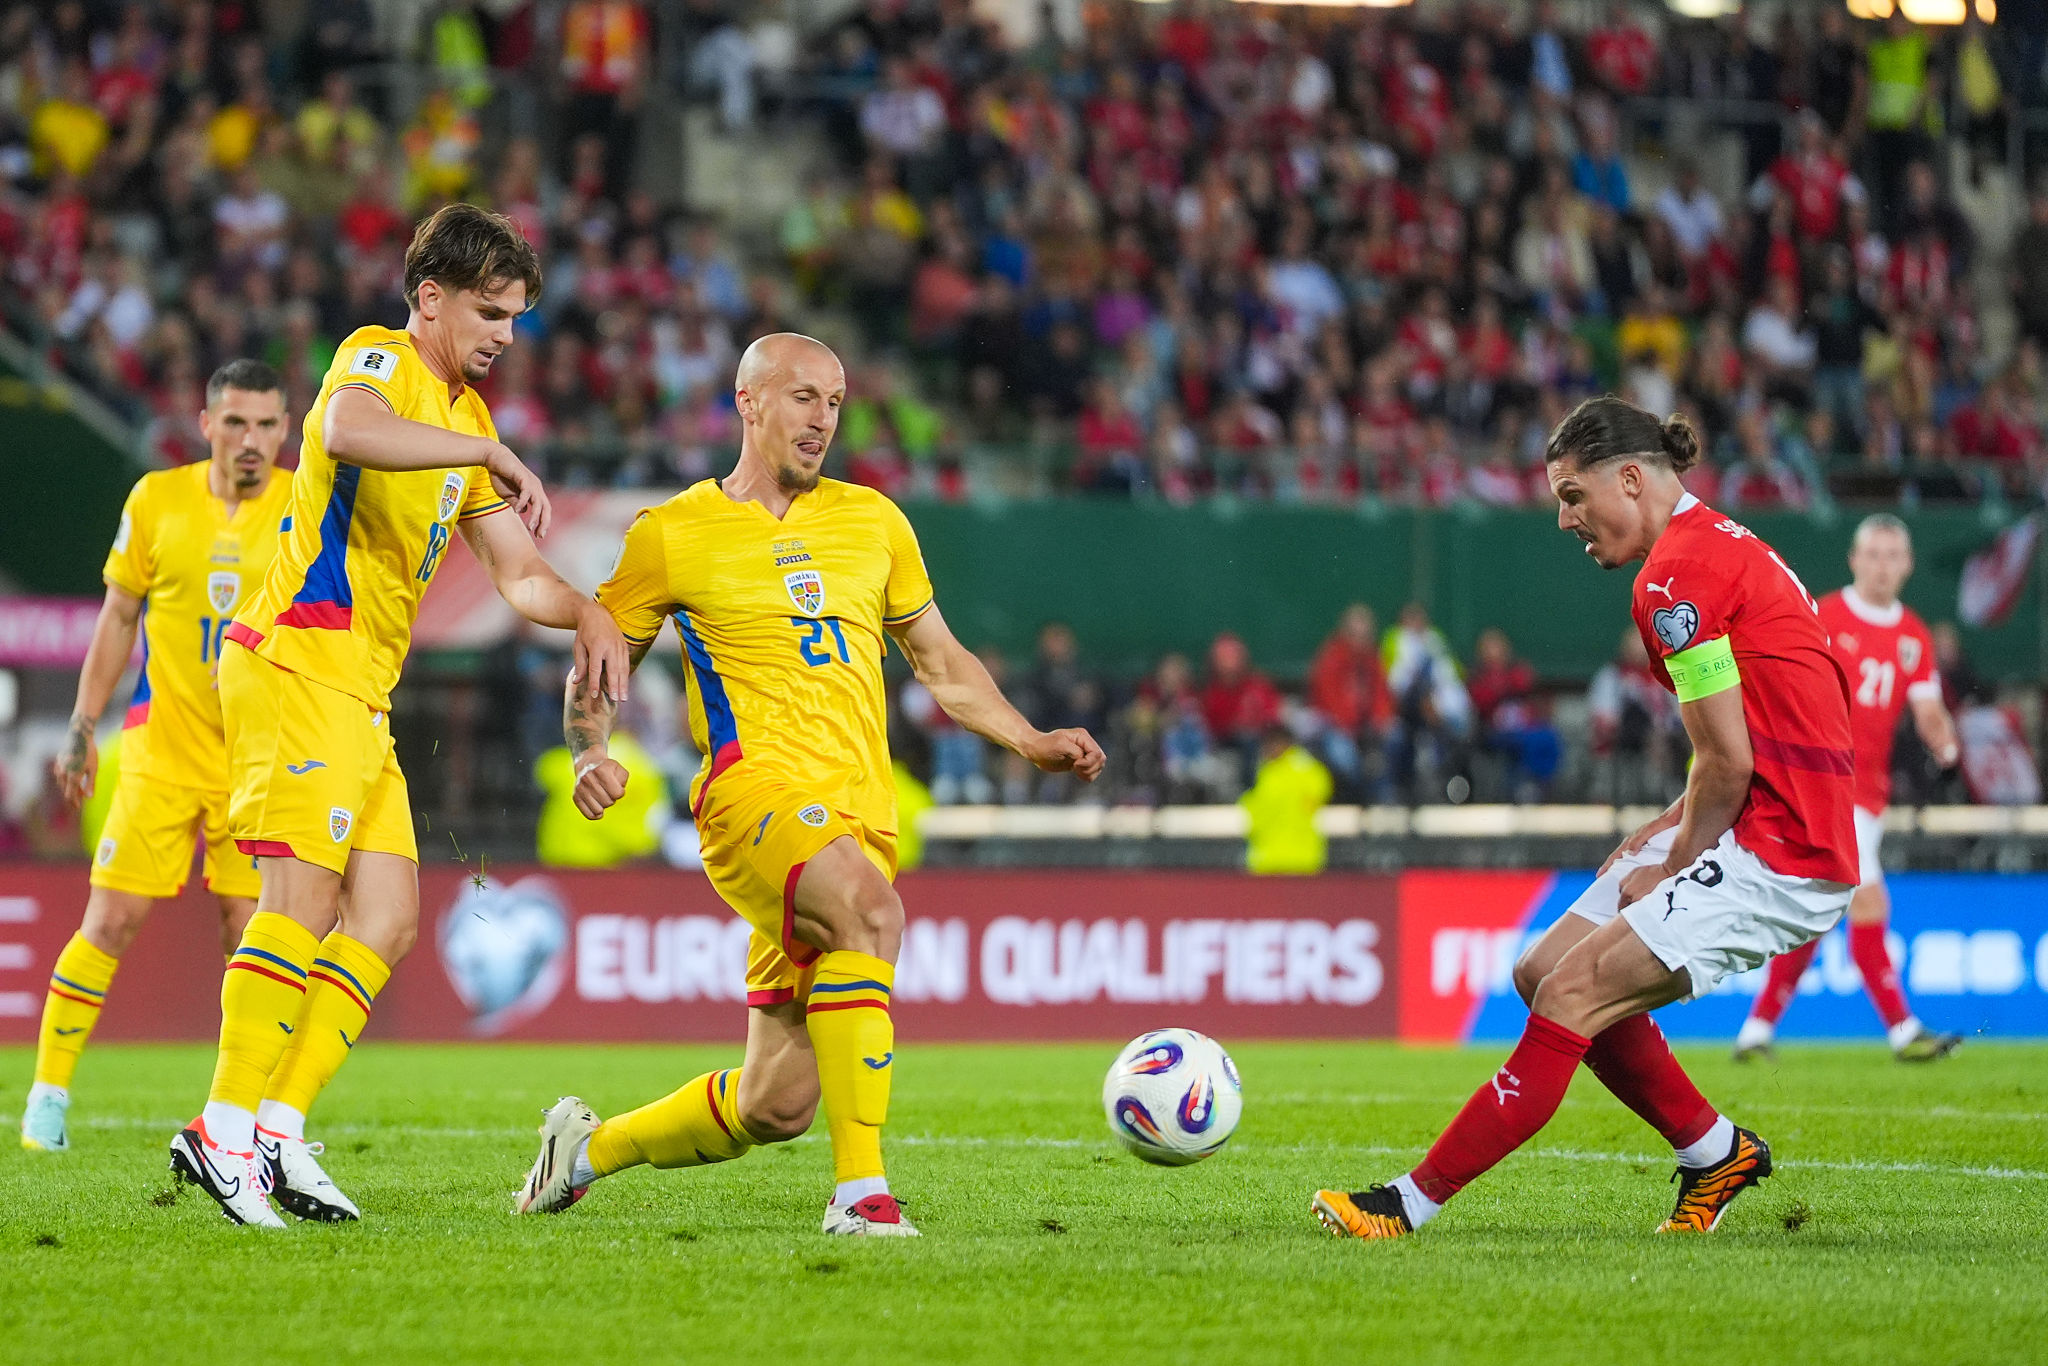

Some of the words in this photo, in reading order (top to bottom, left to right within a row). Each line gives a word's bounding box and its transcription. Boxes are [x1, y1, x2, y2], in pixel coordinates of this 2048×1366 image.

[416, 521, 447, 582] 18
[791, 616, 851, 667] 21
[1857, 657, 1896, 711] 21
[980, 916, 1384, 1005] QUALIFIERS
